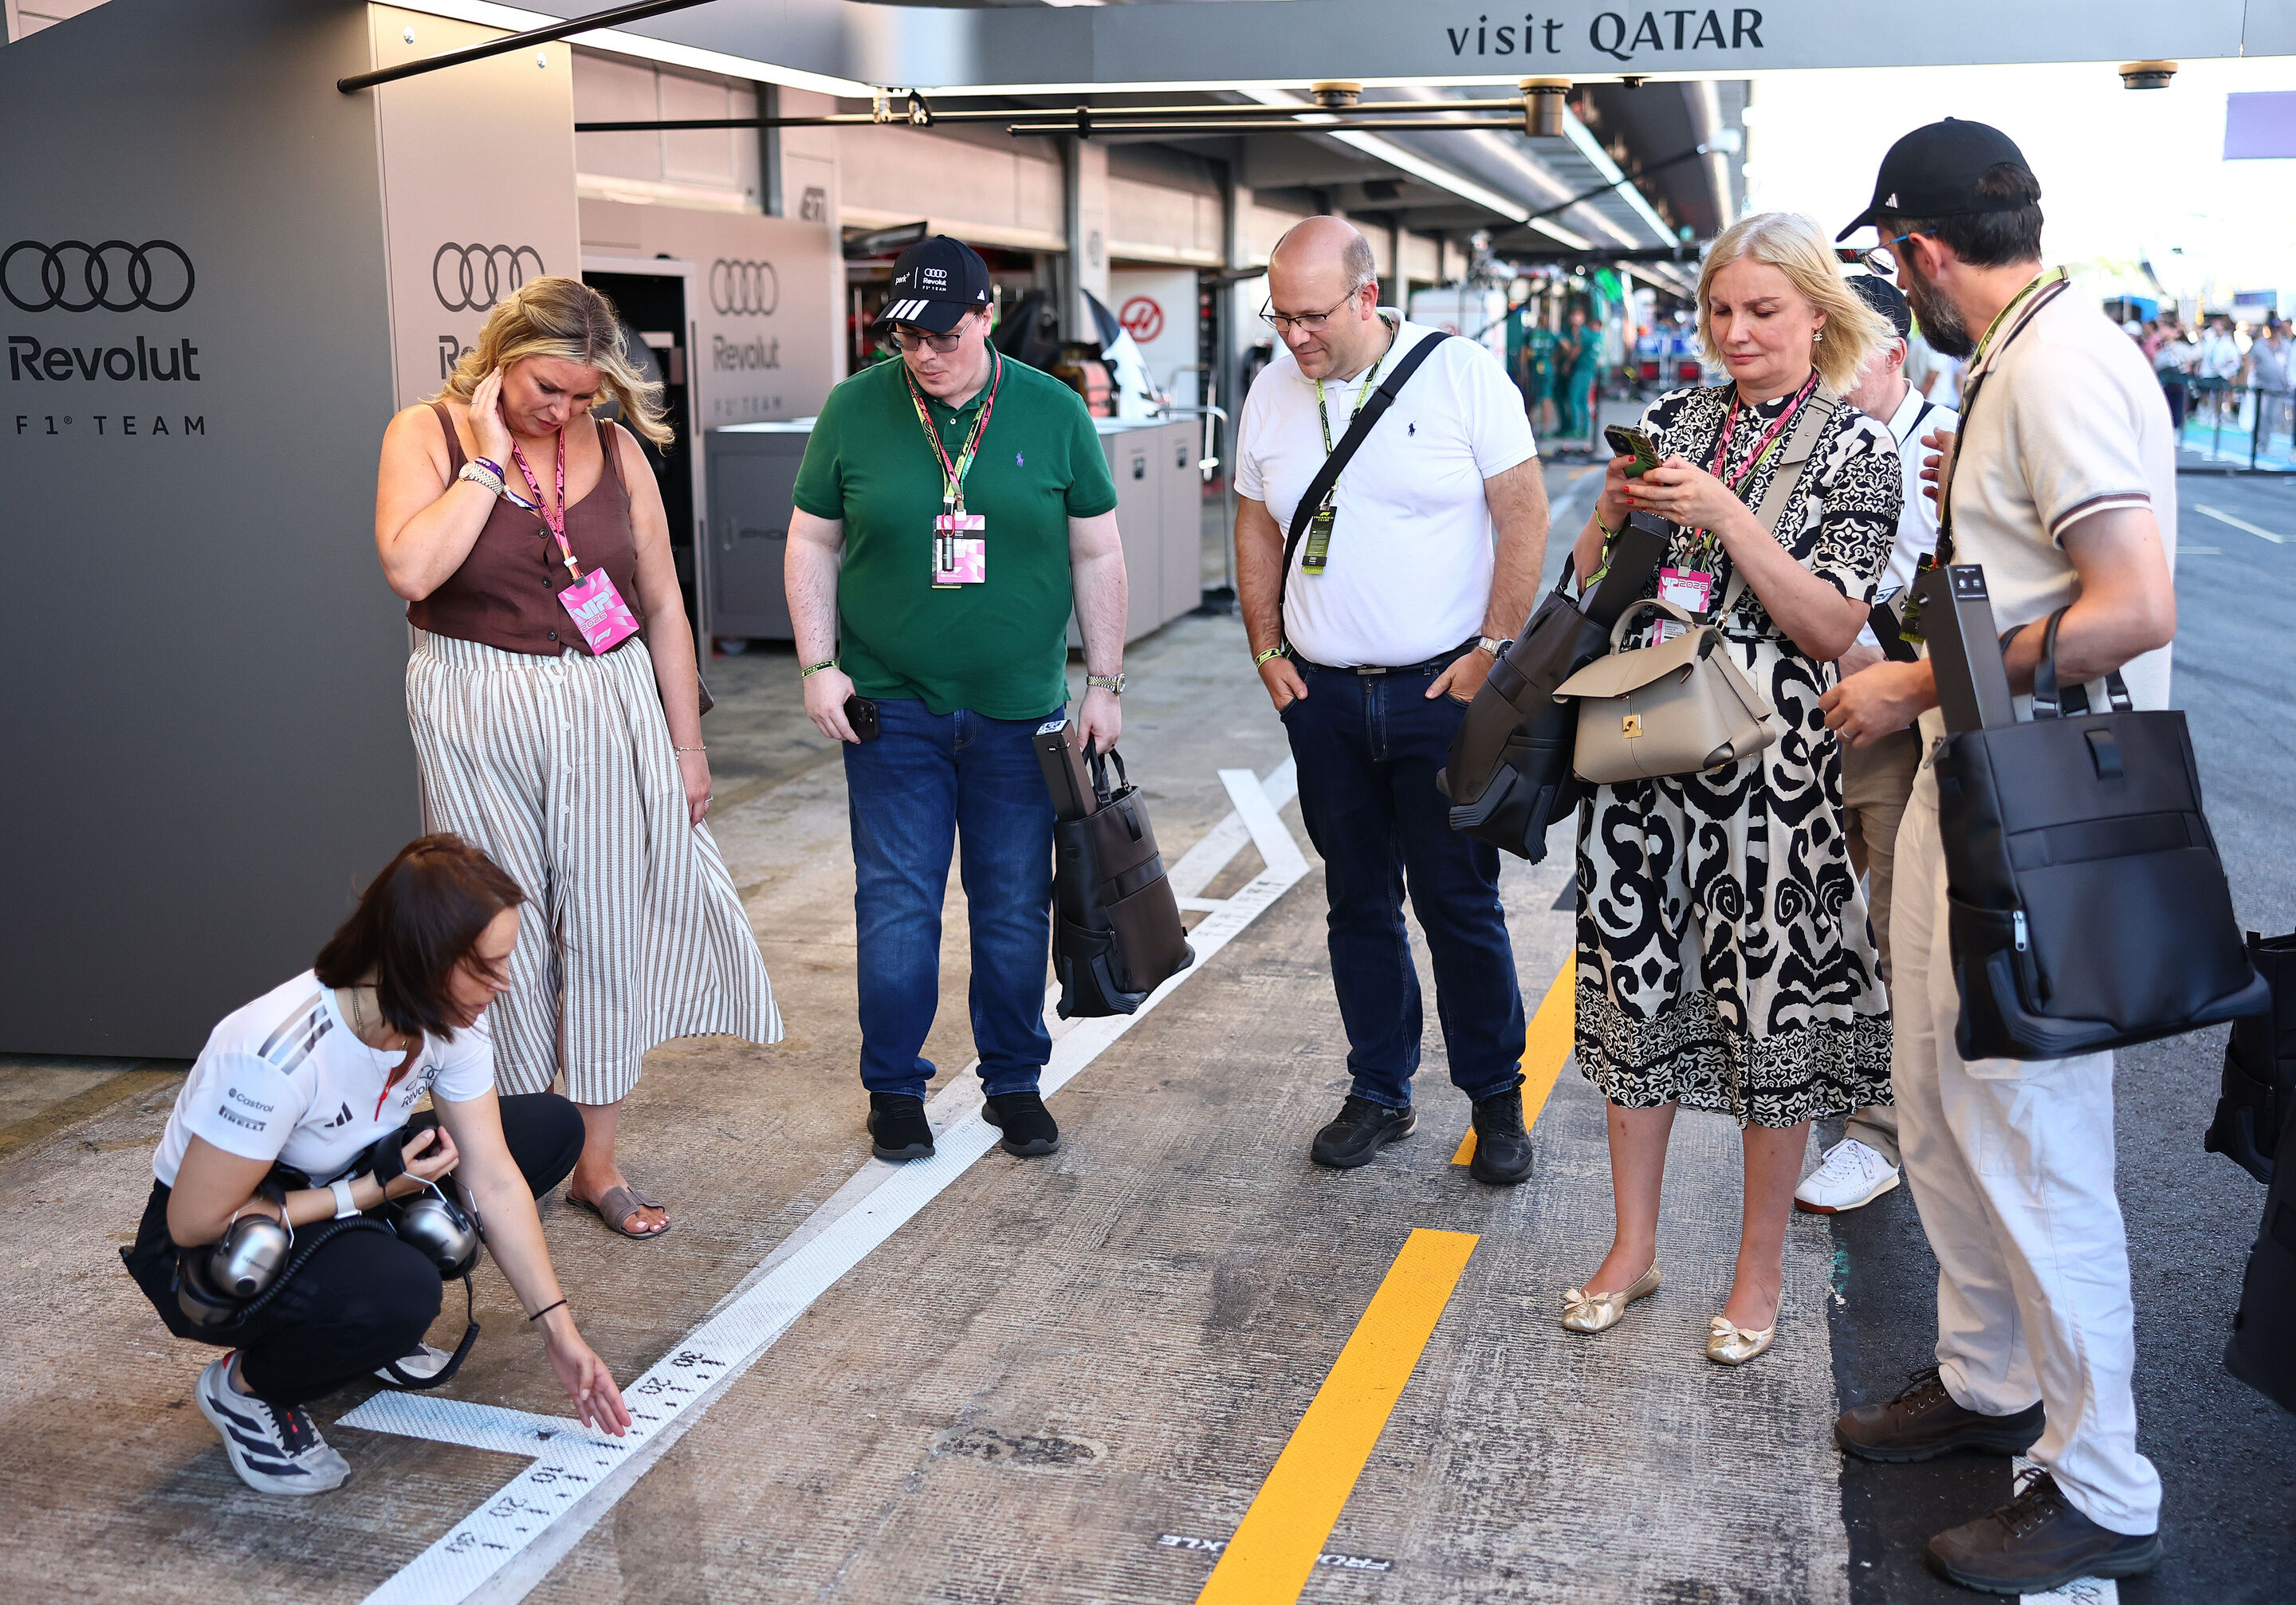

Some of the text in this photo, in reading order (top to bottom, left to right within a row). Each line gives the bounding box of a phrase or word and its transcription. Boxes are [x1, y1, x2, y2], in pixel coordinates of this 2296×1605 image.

[1446, 8, 1765, 62] visit QATAR
[922, 277, 947, 286] Revolut
[7, 335, 201, 381] Revolut
[714, 335, 780, 371] Revolut
[92, 415, 205, 435] TEAM
[1773, 408, 1792, 428] 2026
[1661, 576, 1709, 592] VIP 2026
[572, 591, 611, 620] VIP
[237, 1093, 275, 1113] Castrol
[218, 1104, 267, 1132] PIRELLI
[671, 1350, 704, 1368] 30
[638, 1377, 671, 1395] 20
[530, 1466, 564, 1484] 10
[488, 1496, 529, 1517] 20
[1156, 1534, 1391, 1571] FRO XLE
